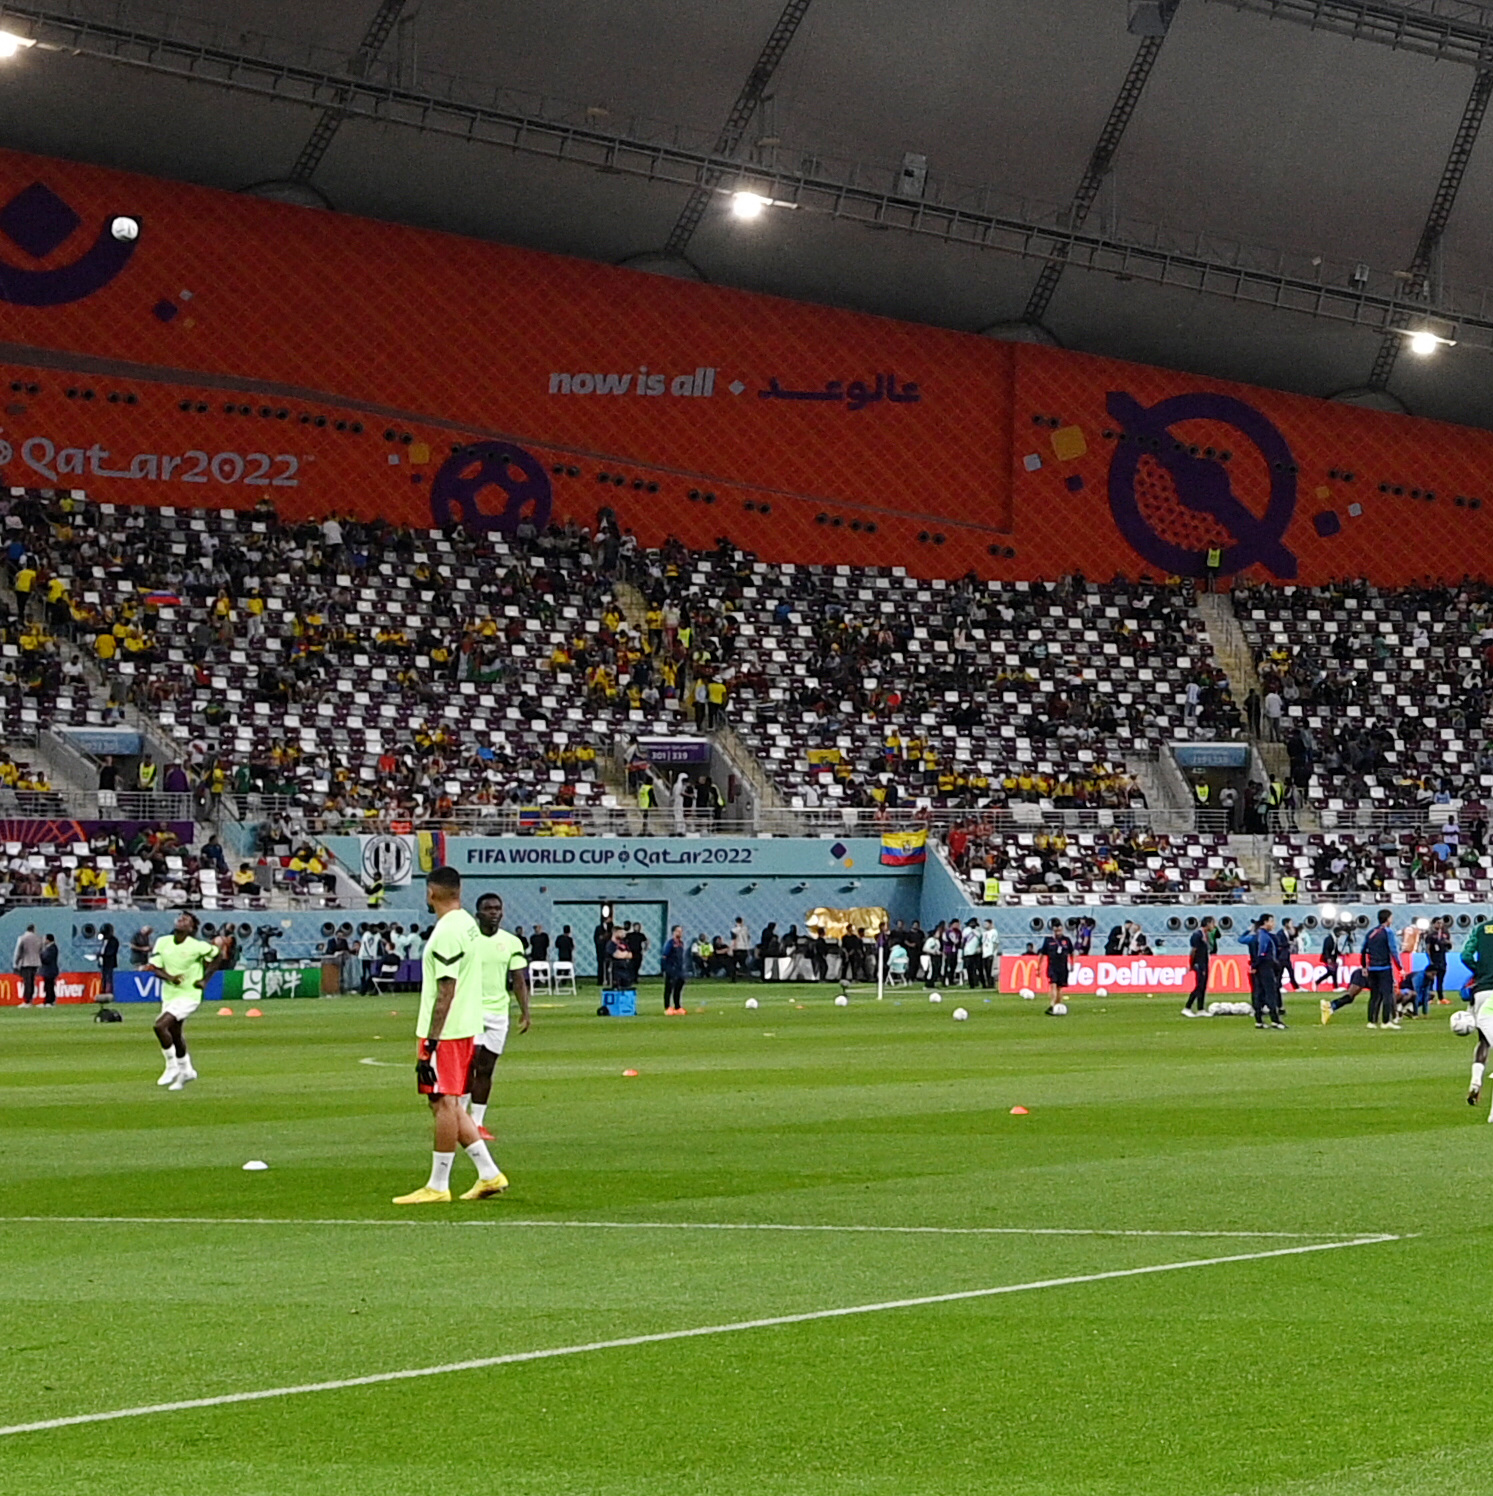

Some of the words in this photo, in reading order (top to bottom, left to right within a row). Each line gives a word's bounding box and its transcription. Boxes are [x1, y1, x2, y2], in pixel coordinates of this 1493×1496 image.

[549, 371, 633, 396] now
[636, 365, 666, 396] is
[671, 367, 717, 397] all
[467, 849, 506, 864] FIFA
[509, 849, 576, 864] WORLD
[579, 849, 615, 864] CUP
[265, 970, 302, 998] 蒙牛
[1096, 960, 1187, 987] Deliver
